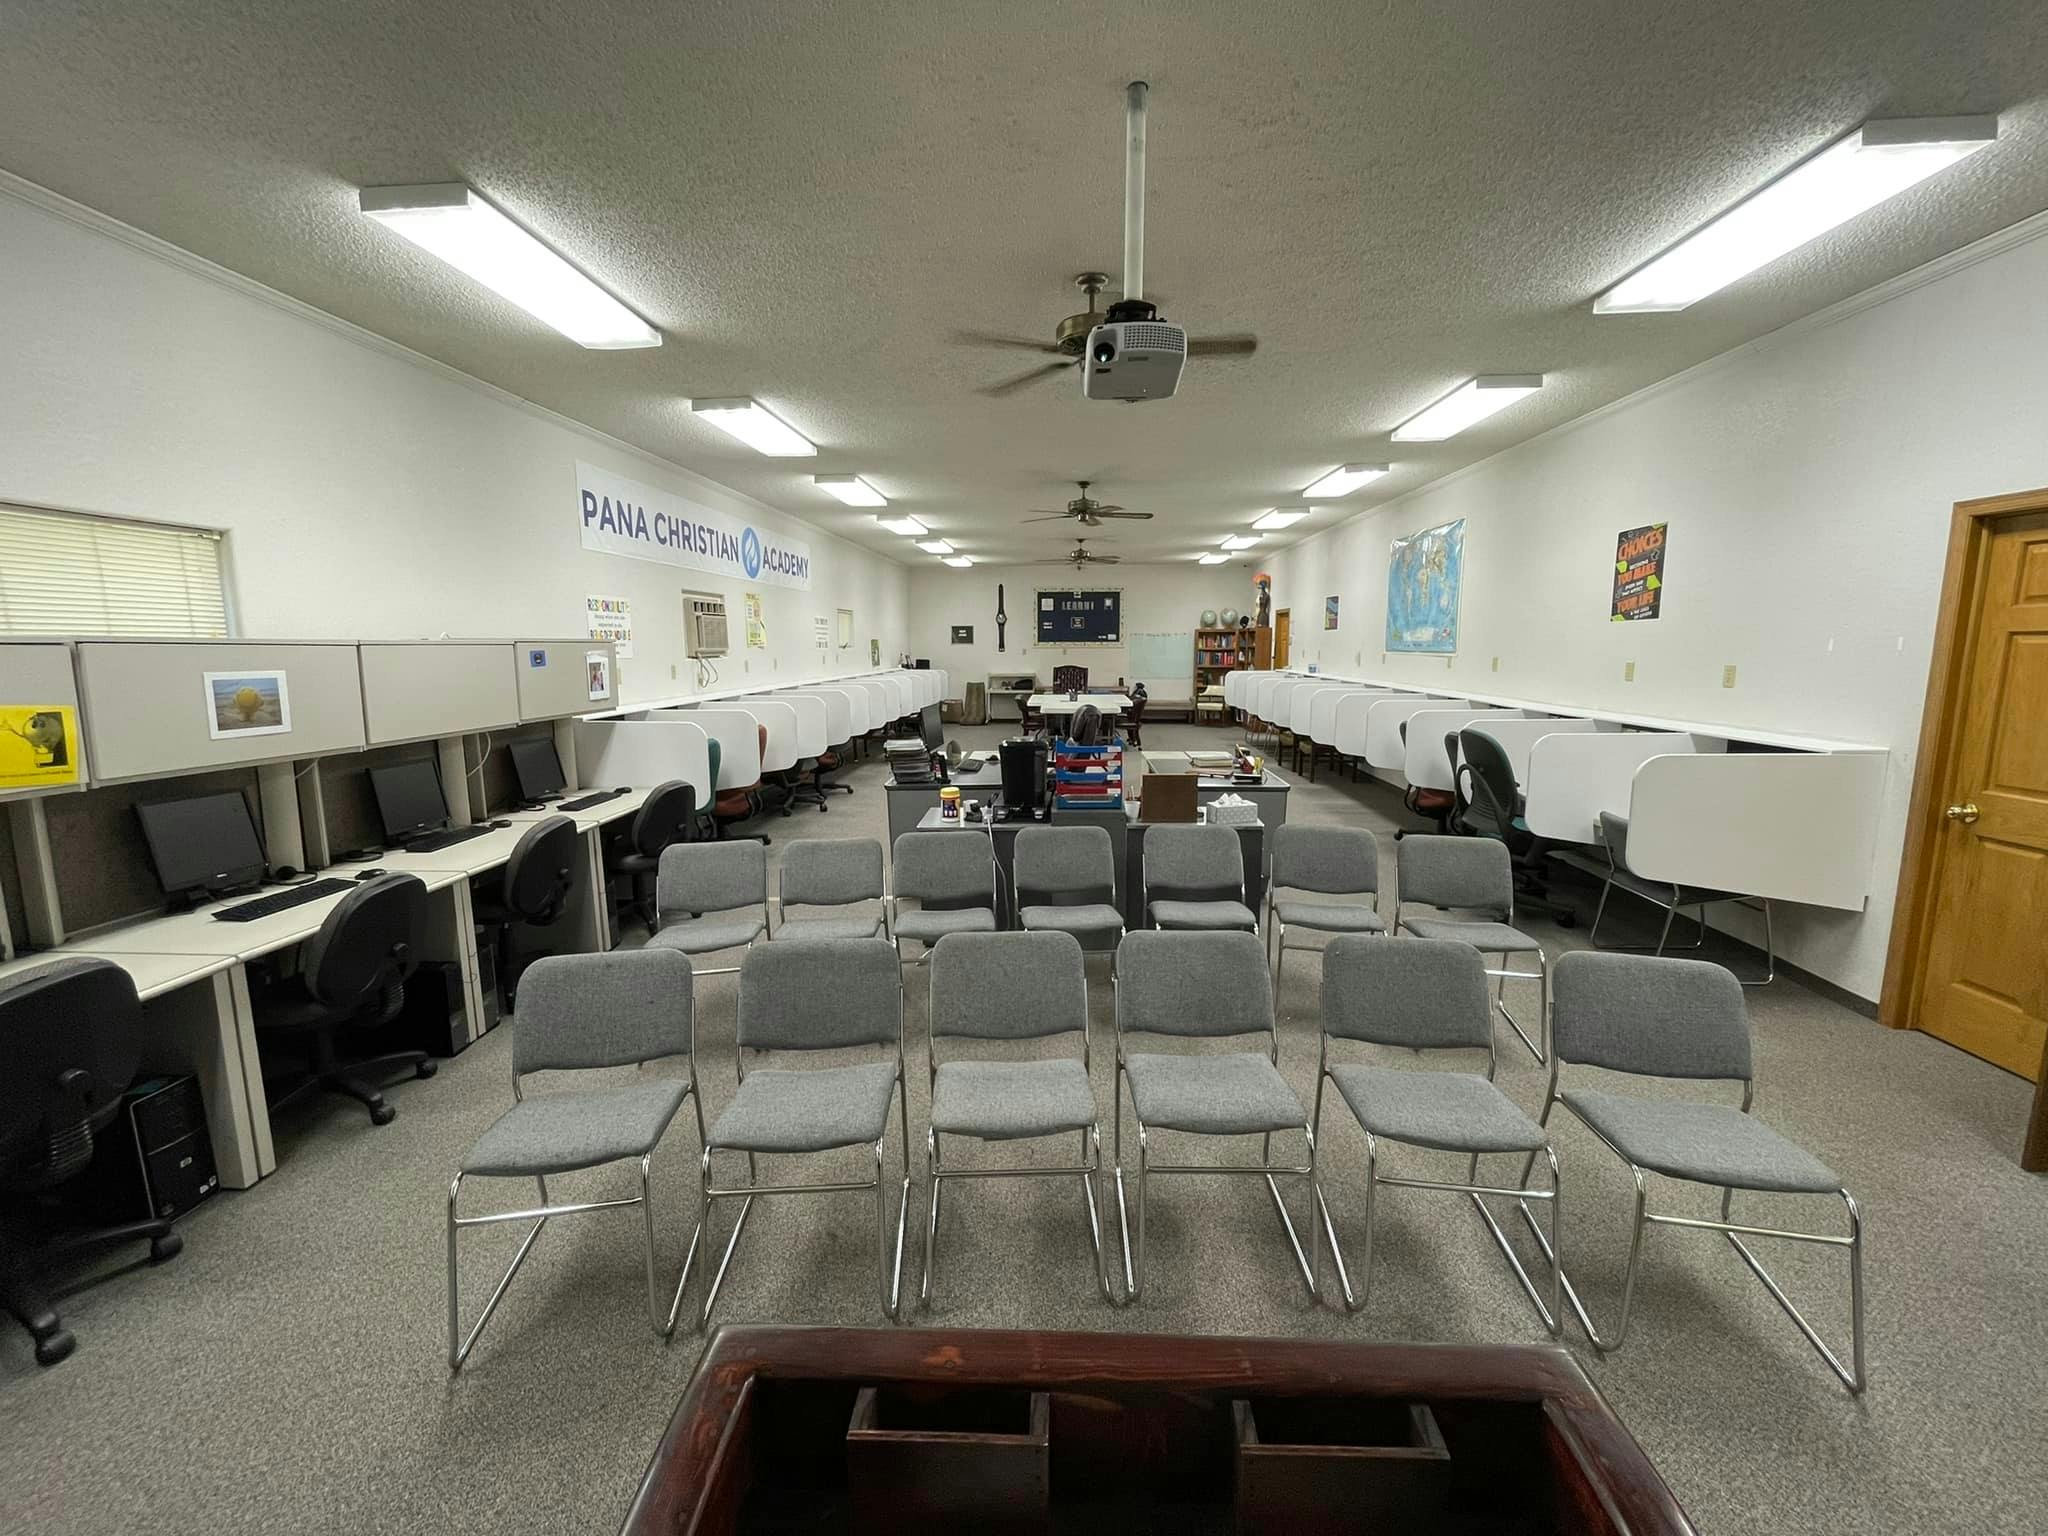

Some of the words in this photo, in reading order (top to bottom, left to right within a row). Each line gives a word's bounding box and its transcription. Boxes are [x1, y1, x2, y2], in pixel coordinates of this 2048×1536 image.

[582, 489, 649, 541] PANA
[654, 513, 739, 562] CHRISTIAN
[763, 546, 809, 578] ACADEMY
